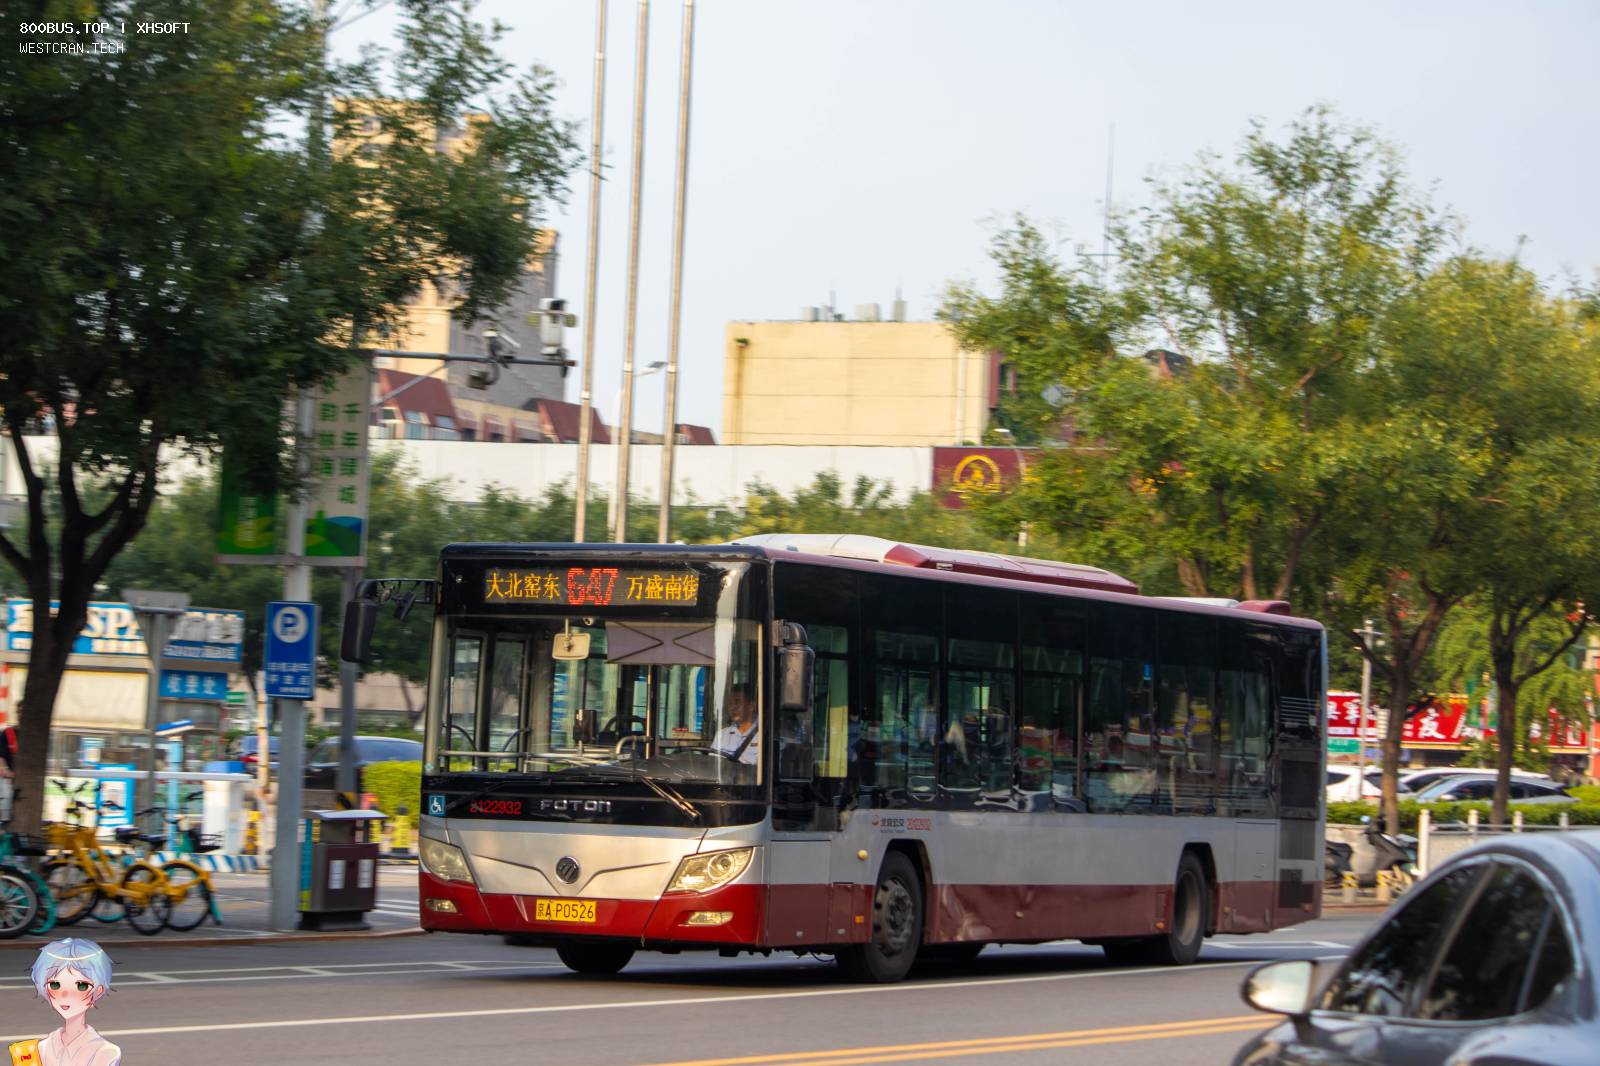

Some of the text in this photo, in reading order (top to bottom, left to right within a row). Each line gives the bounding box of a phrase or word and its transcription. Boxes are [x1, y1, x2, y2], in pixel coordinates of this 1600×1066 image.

[485, 567, 700, 606] 大北窑东 647 万盛南街
[539, 799, 612, 813] FOTON
